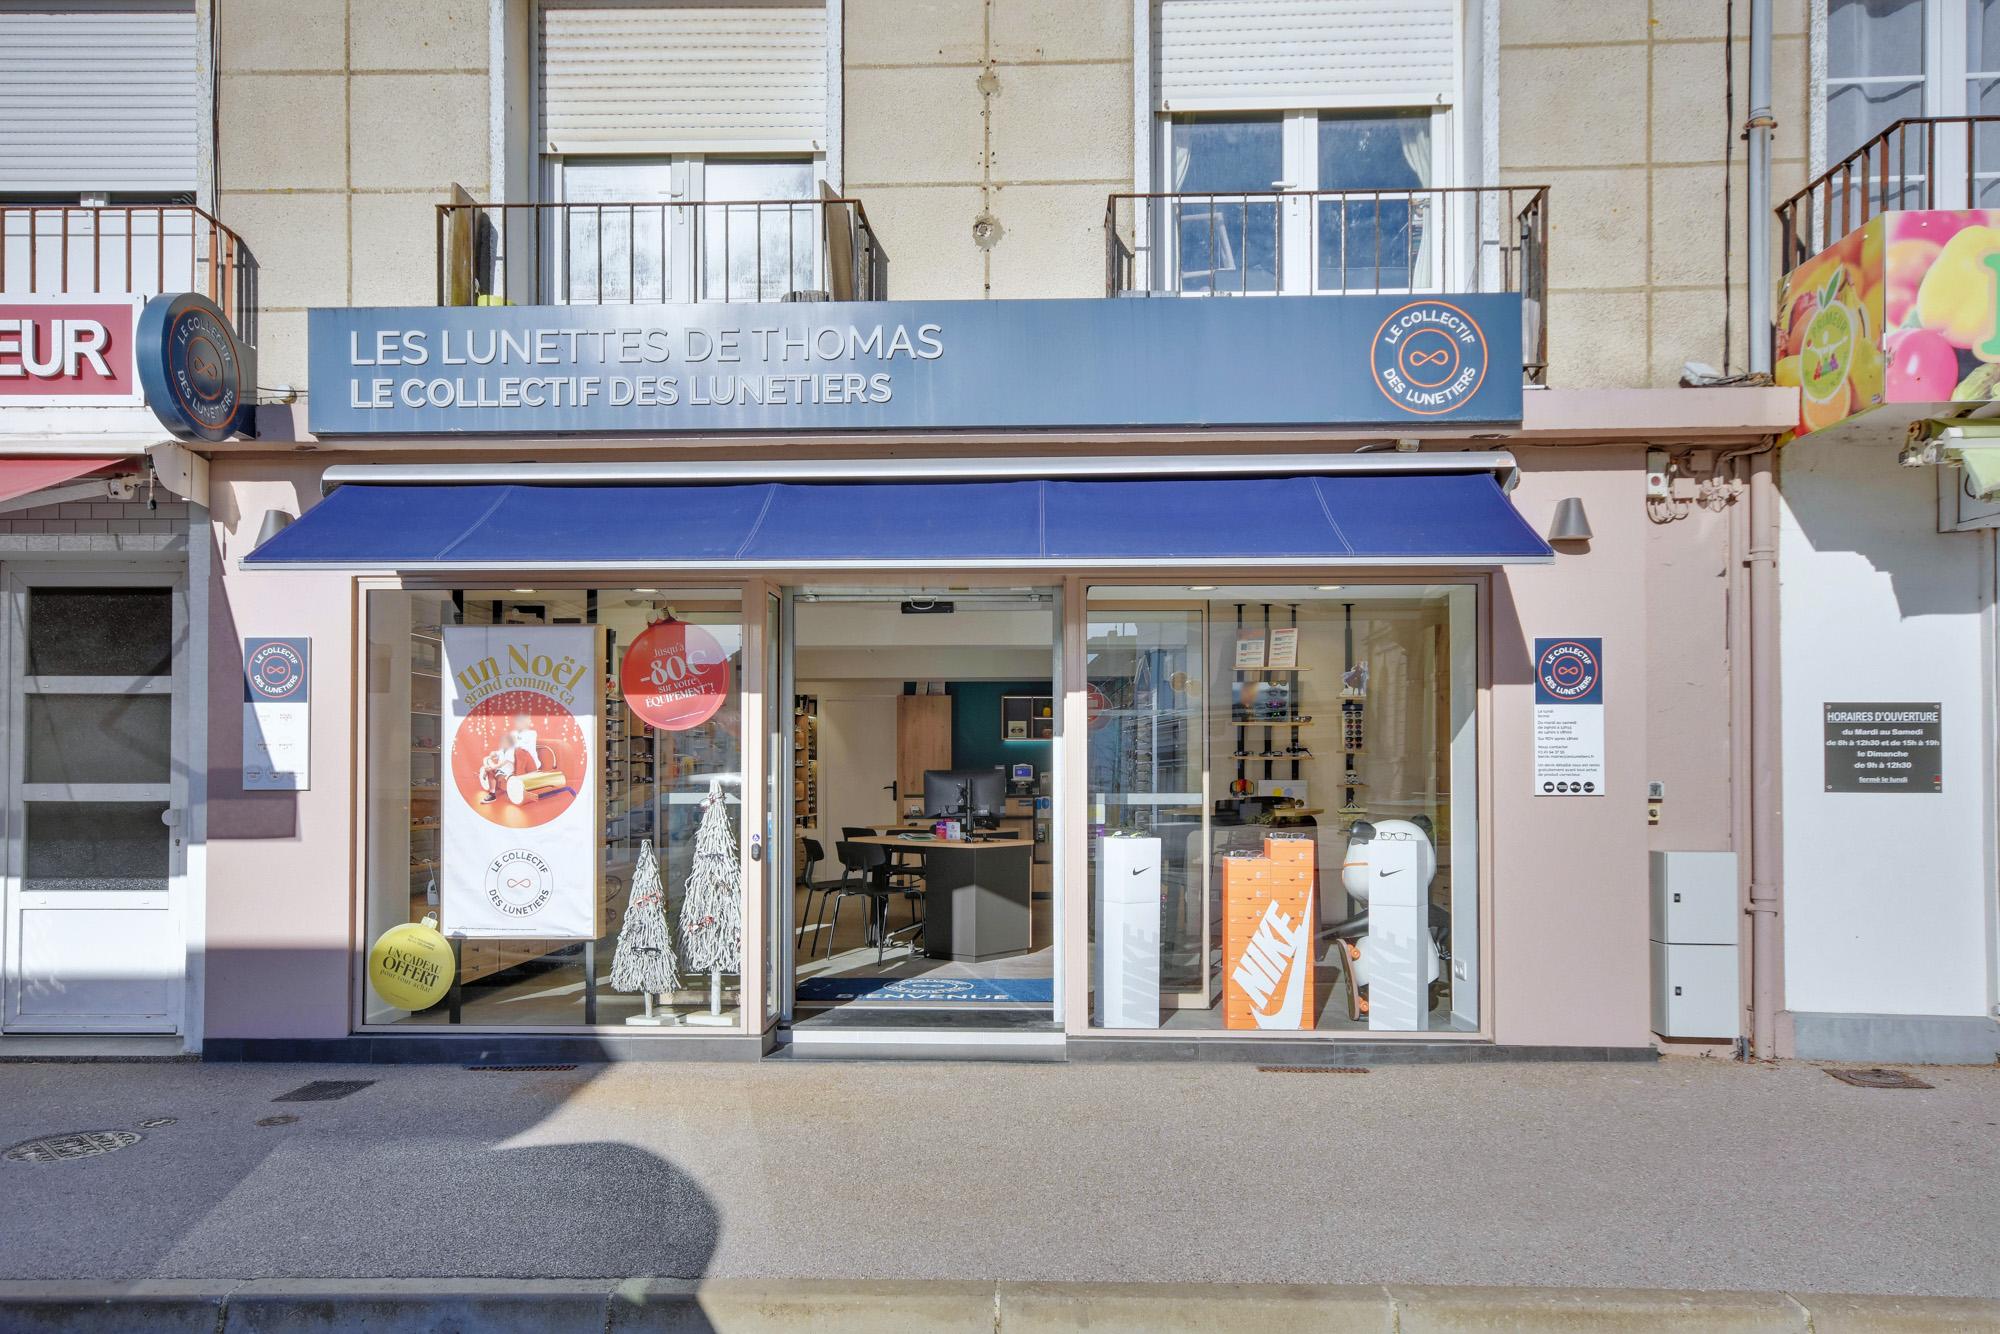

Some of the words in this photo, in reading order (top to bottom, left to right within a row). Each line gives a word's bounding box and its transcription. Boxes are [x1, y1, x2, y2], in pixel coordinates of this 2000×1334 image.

[177, 326, 189, 345] LE
[187, 317, 233, 369] COLLECTIF
[1384, 324, 1403, 345] LE
[1401, 310, 1476, 345] COLLECTIF
[0, 319, 111, 377] EUR
[350, 329, 429, 366] LES
[442, 328, 669, 366] LUNETTES
[684, 328, 741, 363] DE
[752, 324, 944, 362] THOMAS
[177, 370, 192, 400] DES
[192, 388, 235, 419] LUNETIERS
[350, 378, 395, 409] LE
[400, 376, 600, 408] COLLECTIF
[609, 375, 680, 406] DES
[689, 373, 892, 405] LUNETIERS
[1383, 367, 1407, 394] DES
[1406, 366, 1476, 405] LUNETIERS
[255, 653, 264, 665] LE
[262, 647, 298, 665] COLLECTIF
[457, 655, 502, 691] un
[507, 644, 588, 691] Noël
[1545, 652, 1555, 665] LE
[1553, 647, 1592, 666] COLLECTIF
[253, 674, 265, 689] DES
[264, 674, 298, 694] LUNETIERS
[464, 676, 503, 707] grand
[504, 676, 559, 695] comme
[1544, 675, 1557, 690] DES
[1556, 675, 1592, 695] LUNETIERS
[1827, 712, 1873, 721] HORAIRES
[1875, 712, 1939, 721] D'OUVERTURE
[491, 860, 503, 873] LE
[502, 851, 549, 874] COLLECTIF
[489, 889, 503, 907] DES
[503, 889, 549, 915] LUNETIERS
[388, 946, 403, 959] UN
[1231, 900, 1302, 1010] NIKE
[383, 956, 439, 988] OFFERT
